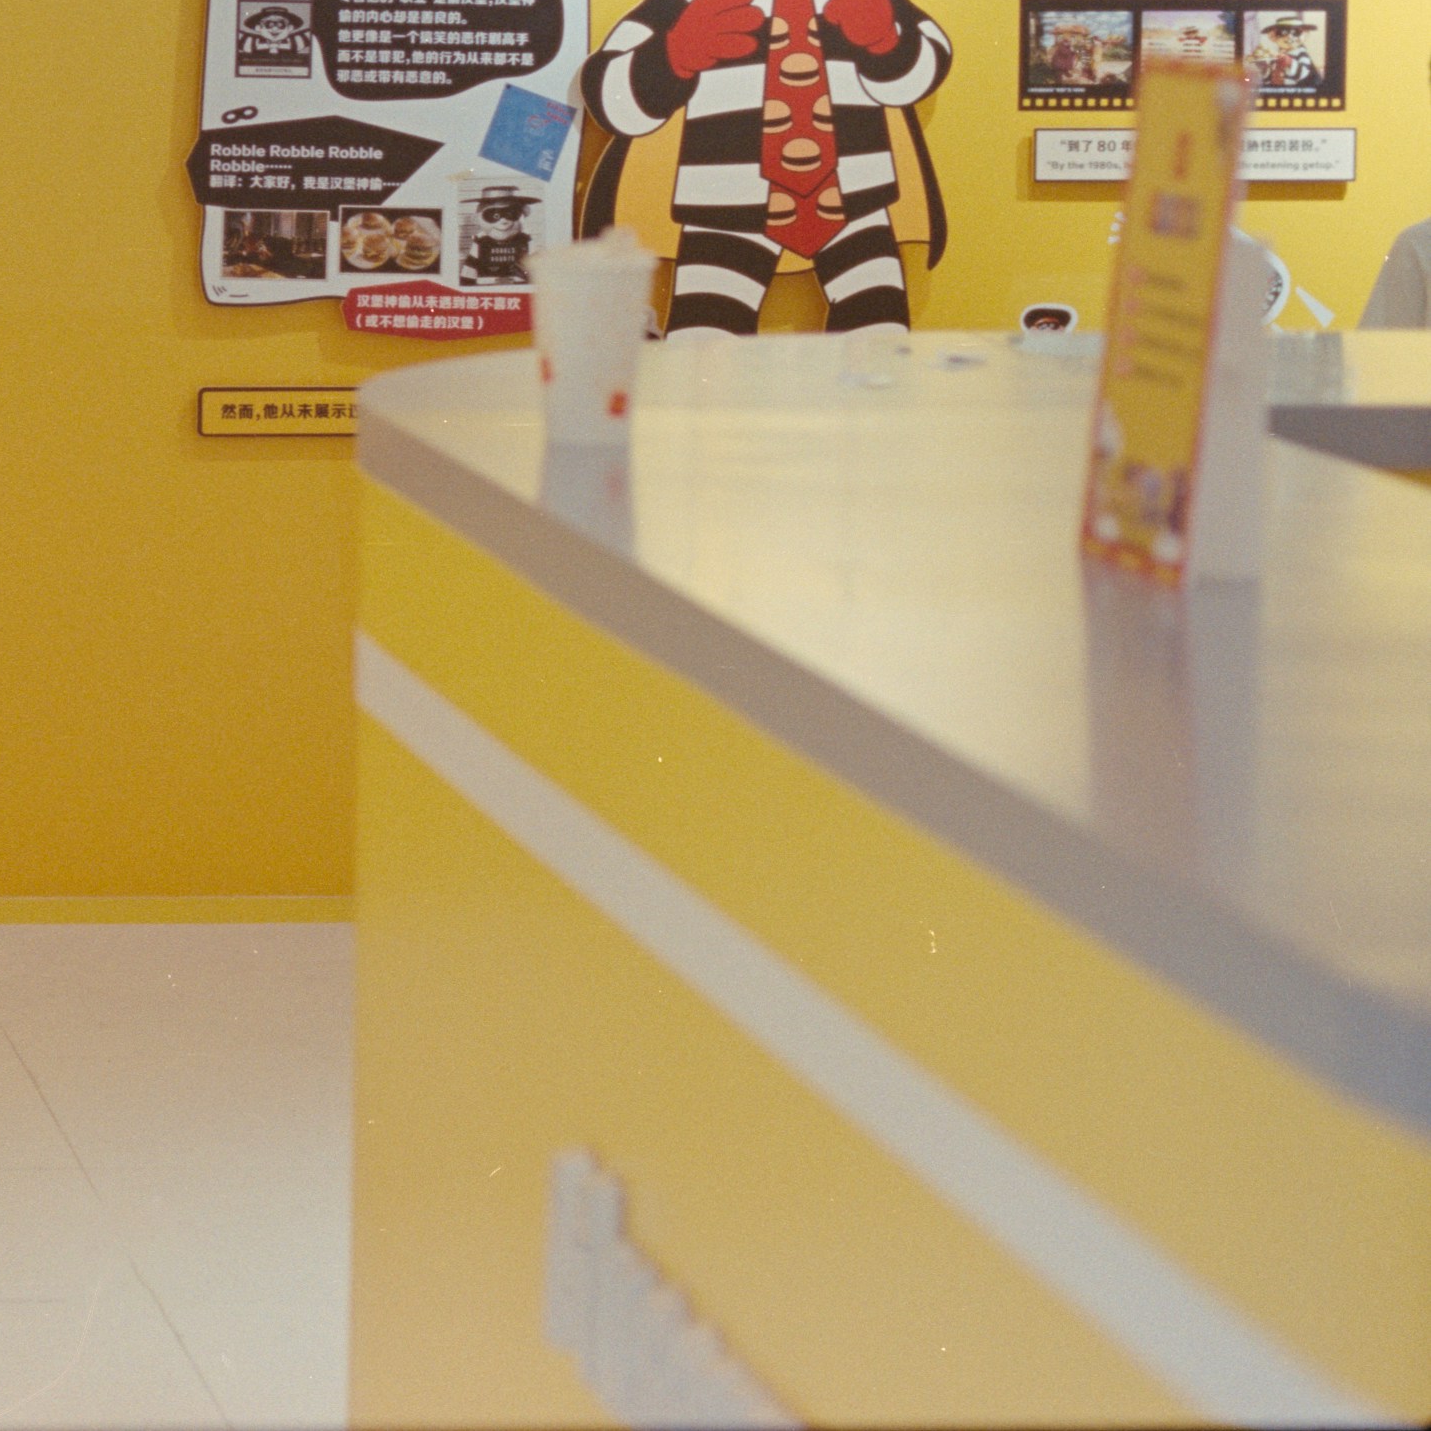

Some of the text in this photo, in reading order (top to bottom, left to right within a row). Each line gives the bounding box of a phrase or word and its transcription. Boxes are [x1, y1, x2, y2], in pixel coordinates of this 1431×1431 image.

[210, 143, 384, 160] Robble Robble Robble
